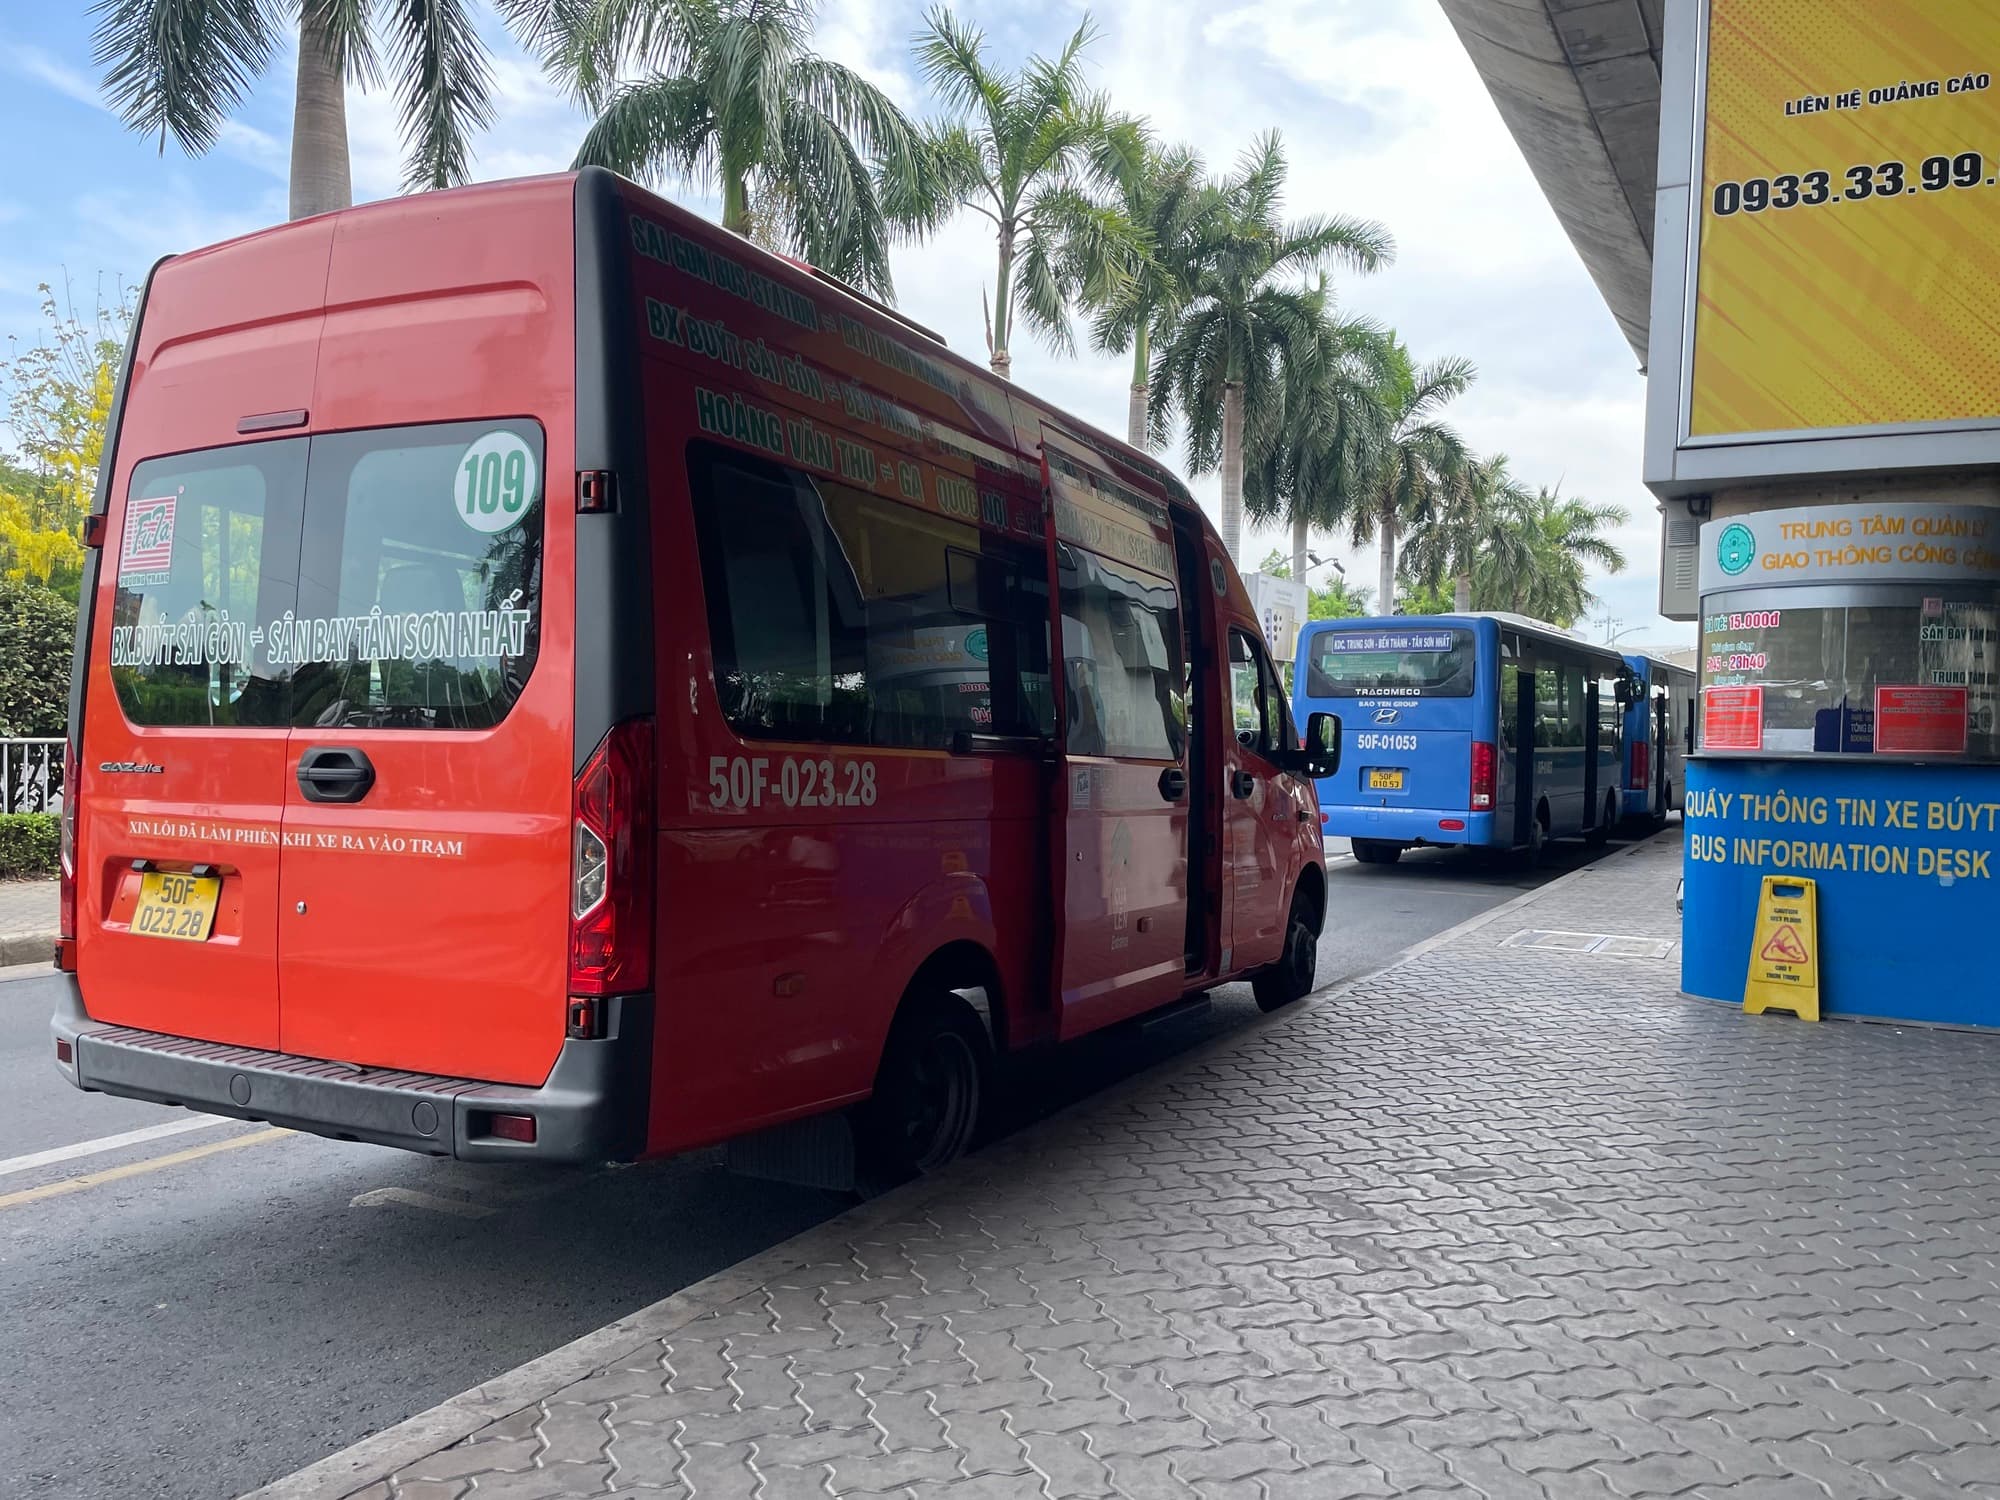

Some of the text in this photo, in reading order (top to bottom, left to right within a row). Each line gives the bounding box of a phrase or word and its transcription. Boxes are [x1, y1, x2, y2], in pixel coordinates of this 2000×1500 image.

[1785, 72, 1990, 116] LIÊN HỆ QUẢNG CÁO
[1713, 152, 2000, 217] 0933.33.99.
[749, 271, 819, 333] STATION
[645, 295, 685, 346] BX
[683, 318, 742, 370] BUÝT
[744, 337, 783, 386] SÀI
[782, 354, 826, 404] GÒN
[695, 386, 785, 457] HOÀNG
[786, 416, 835, 473] VĂN
[836, 437, 877, 488] THỤ
[897, 461, 925, 503] GA
[936, 474, 979, 520] QUỐC
[980, 488, 1009, 533] NỘI
[464, 449, 526, 516] 109
[1780, 518, 1851, 541] TRUNG
[1859, 513, 1905, 537] TÂM
[1911, 512, 1967, 537] QUẢN
[1762, 550, 1809, 571] GIAO
[1814, 543, 1892, 567] THÔNG
[1897, 542, 1957, 566] CÔNG
[146, 571, 170, 585] TRANG
[112, 588, 530, 667] BX.BUÝT SÀI GÒN SÂN BAY TÂN SƠN NHẤT
[1729, 611, 1780, 630] 15.000đ
[1921, 623, 1944, 641] SÂN
[1947, 626, 1966, 641] BAY
[1355, 688, 1421, 696] TRACOMECO
[1931, 669, 1966, 684] TRUNG
[1357, 734, 1417, 751] 50F-01053
[709, 756, 877, 808] 50F-023.28
[1740, 789, 1828, 824] THÔNG
[1836, 798, 1876, 826] TIN
[1884, 800, 1919, 828] XE
[128, 820, 152, 836] XIN
[177, 821, 198, 840] ĐÃ
[199, 822, 232, 843] LÀM
[282, 830, 312, 849] KHI
[315, 832, 338, 850] XE
[341, 834, 365, 851] RA
[368, 832, 405, 853] VÀO
[409, 837, 463, 859] TRẠM
[1691, 834, 1991, 878] BUS INFORMATION DESK
[159, 877, 195, 905] 50F
[139, 907, 203, 937] 023.28
